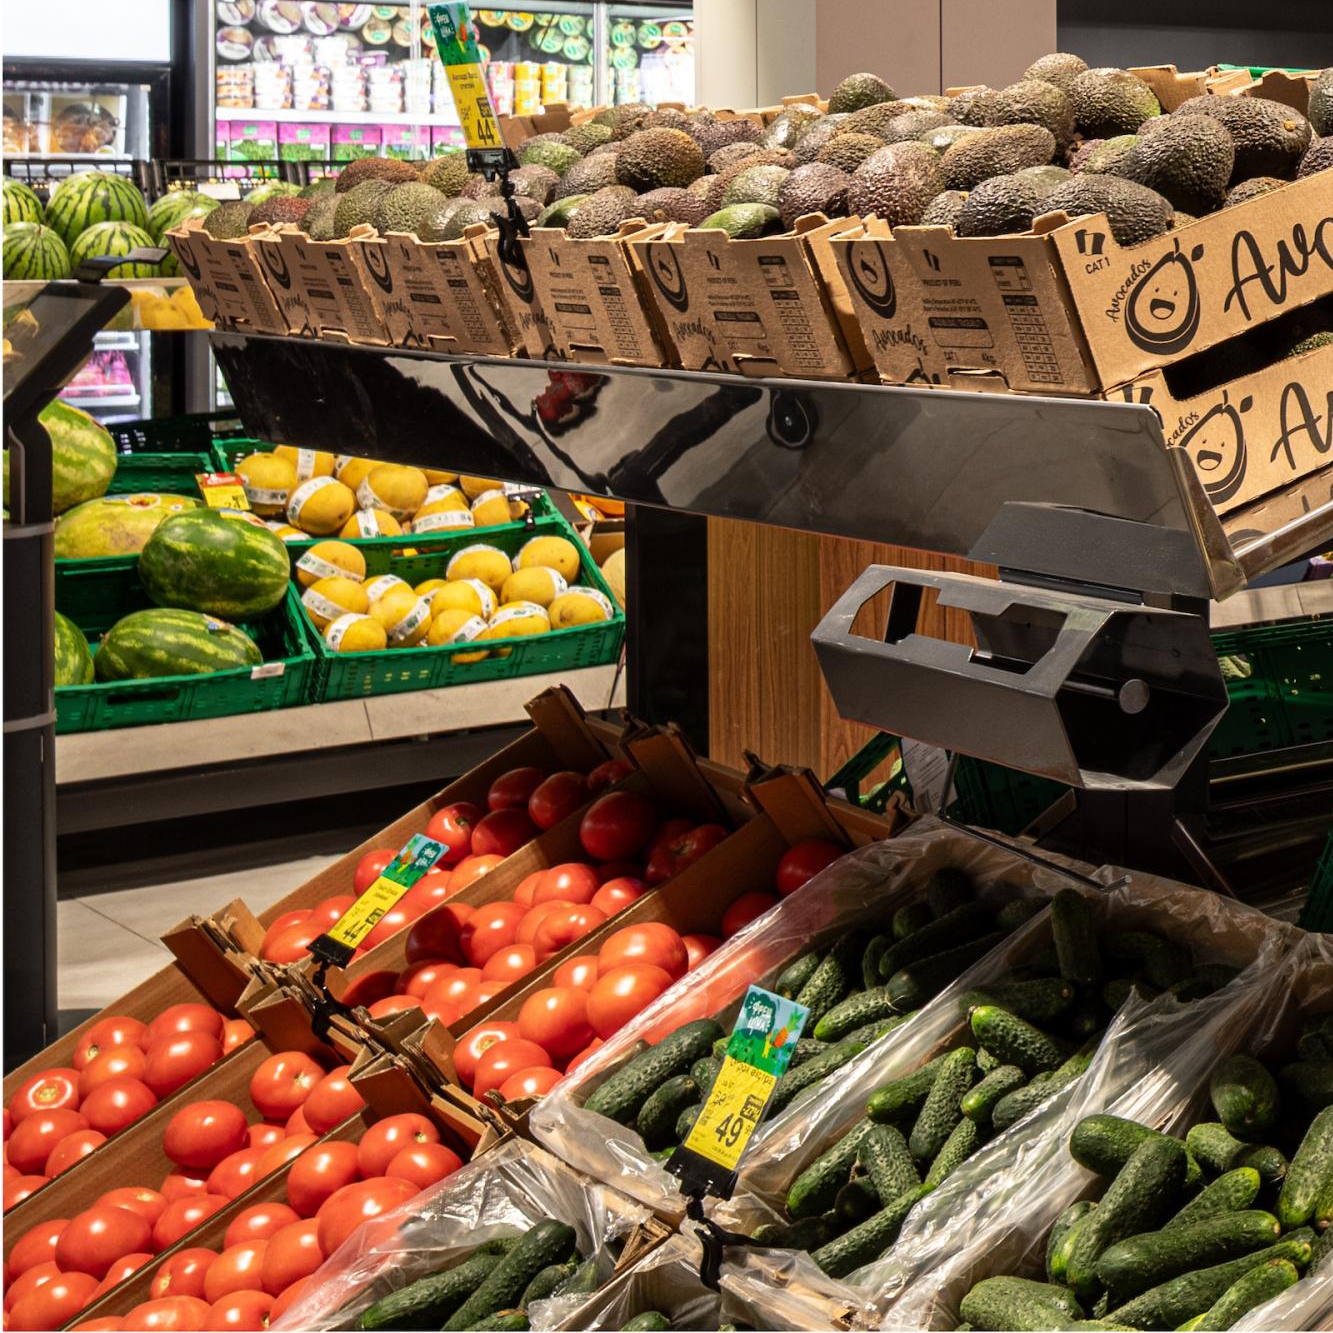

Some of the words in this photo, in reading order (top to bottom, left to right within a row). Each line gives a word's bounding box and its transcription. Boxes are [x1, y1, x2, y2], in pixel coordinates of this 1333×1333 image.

[477, 118, 495, 146] 44
[1106, 258, 1152, 323] Avocados
[872, 323, 929, 356] Avocados
[714, 1112, 745, 1147] 49
